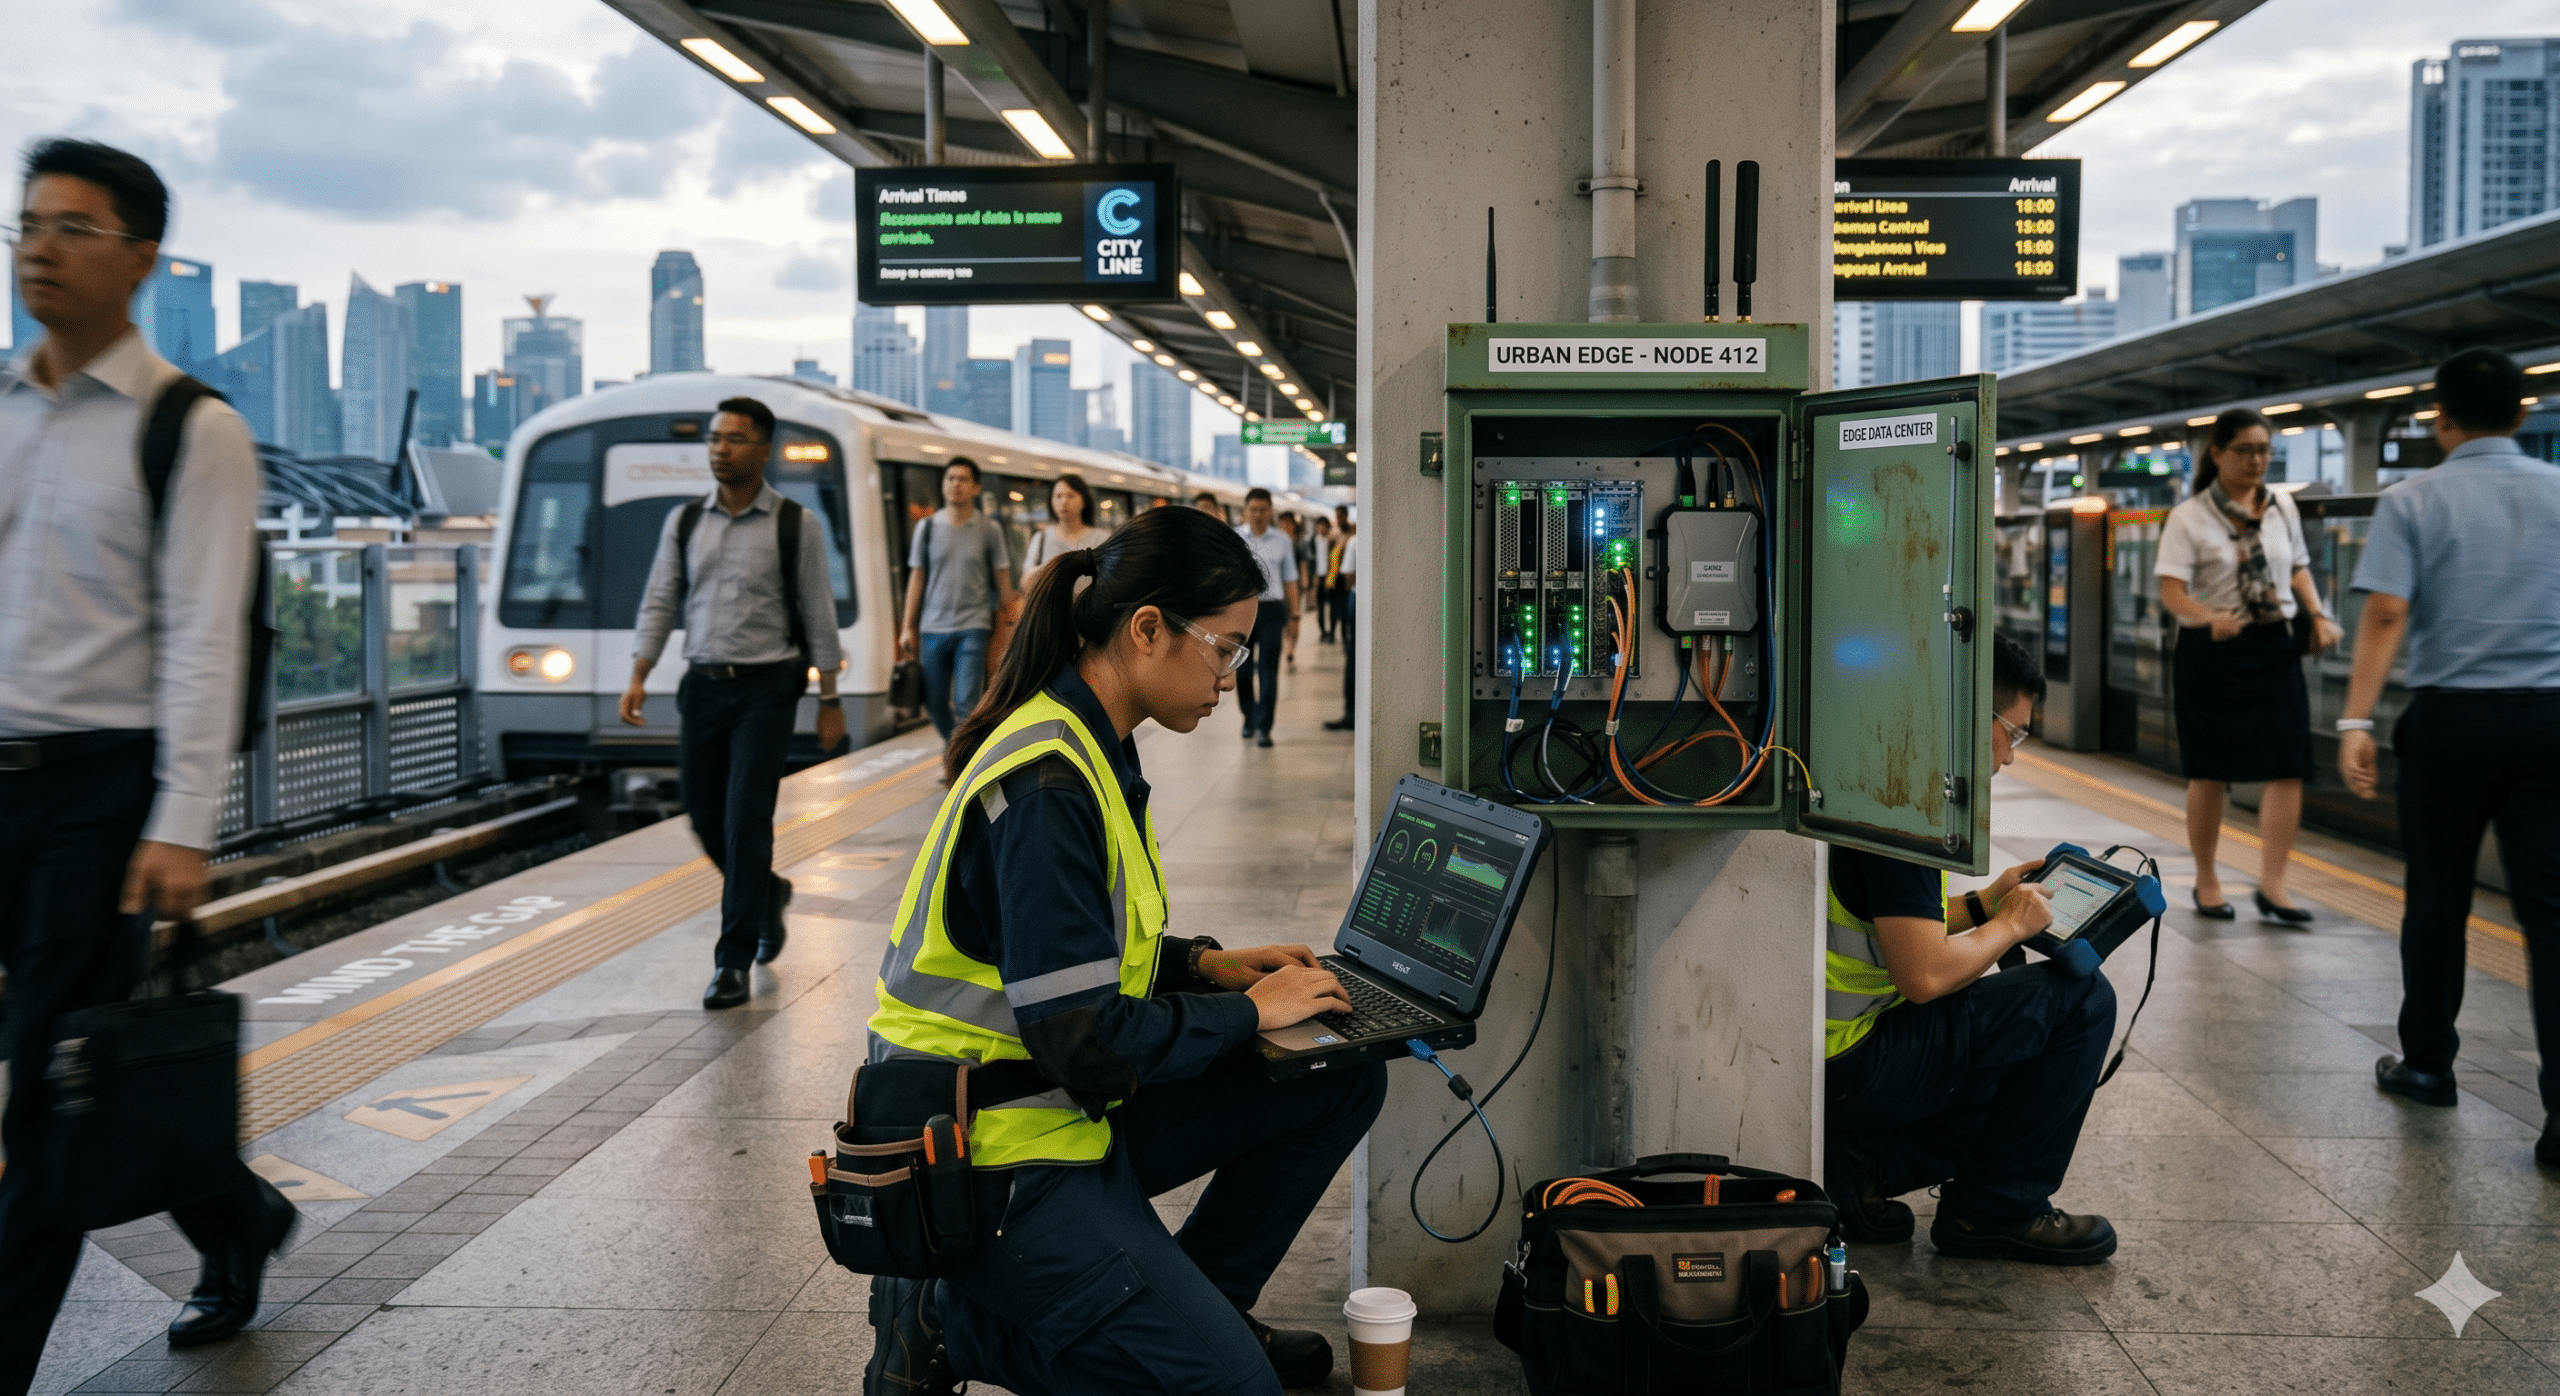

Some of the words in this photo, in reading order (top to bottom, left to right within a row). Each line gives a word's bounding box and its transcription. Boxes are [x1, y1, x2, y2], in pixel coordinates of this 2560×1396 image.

[2009, 177, 2057, 192] Arrival
[879, 188, 924, 203] Arrival
[925, 188, 967, 203] Times
[1097, 239, 1143, 257] CITY
[1098, 257, 1143, 274] LINE
[1497, 346, 1571, 364] URBAN
[1578, 346, 1634, 364] EDGE
[1654, 346, 1713, 364] NODE
[1718, 346, 1758, 364] 412
[1843, 427, 1867, 442] EDGE
[1868, 425, 1893, 440] DATA
[1894, 421, 1933, 438] CENTER
[257, 956, 415, 1005] MIND
[381, 924, 506, 956] THE
